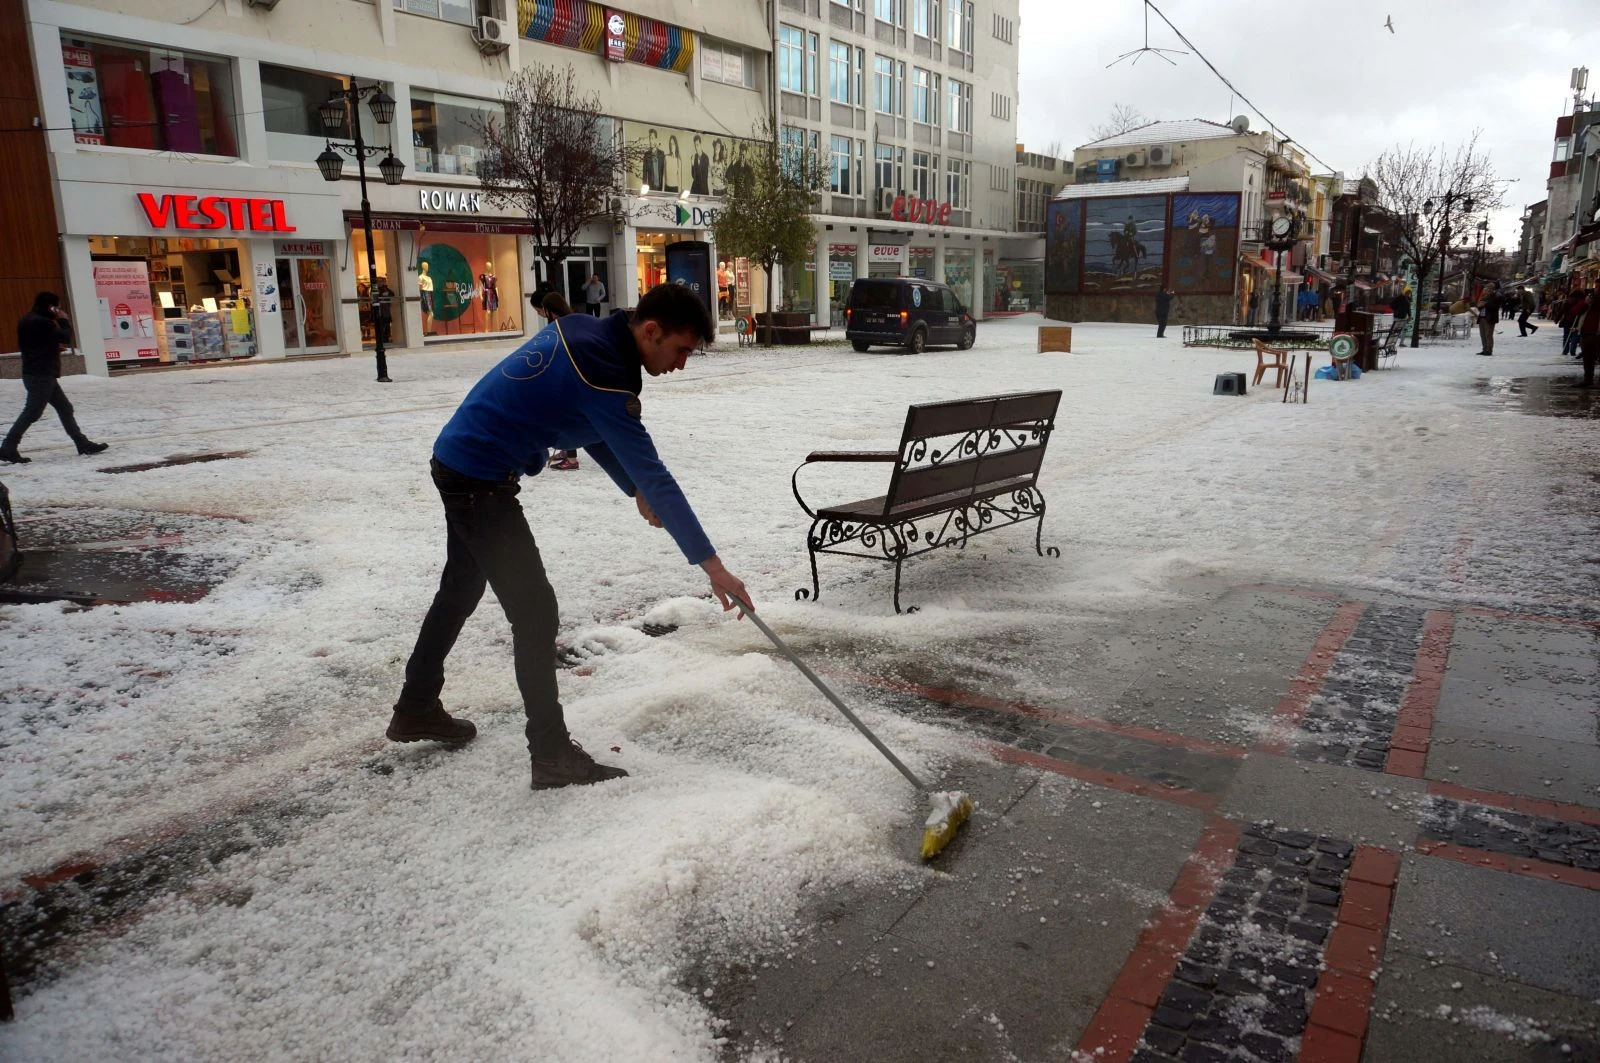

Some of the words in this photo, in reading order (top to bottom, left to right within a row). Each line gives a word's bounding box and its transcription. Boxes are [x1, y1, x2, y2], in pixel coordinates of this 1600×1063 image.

[420, 189, 480, 212] ROMAN
[137, 192, 296, 232] VESTEL
[892, 196, 951, 225] evve
[371, 219, 400, 230] ROMAN
[475, 223, 500, 234] ROMAN
[874, 246, 899, 256] evve
